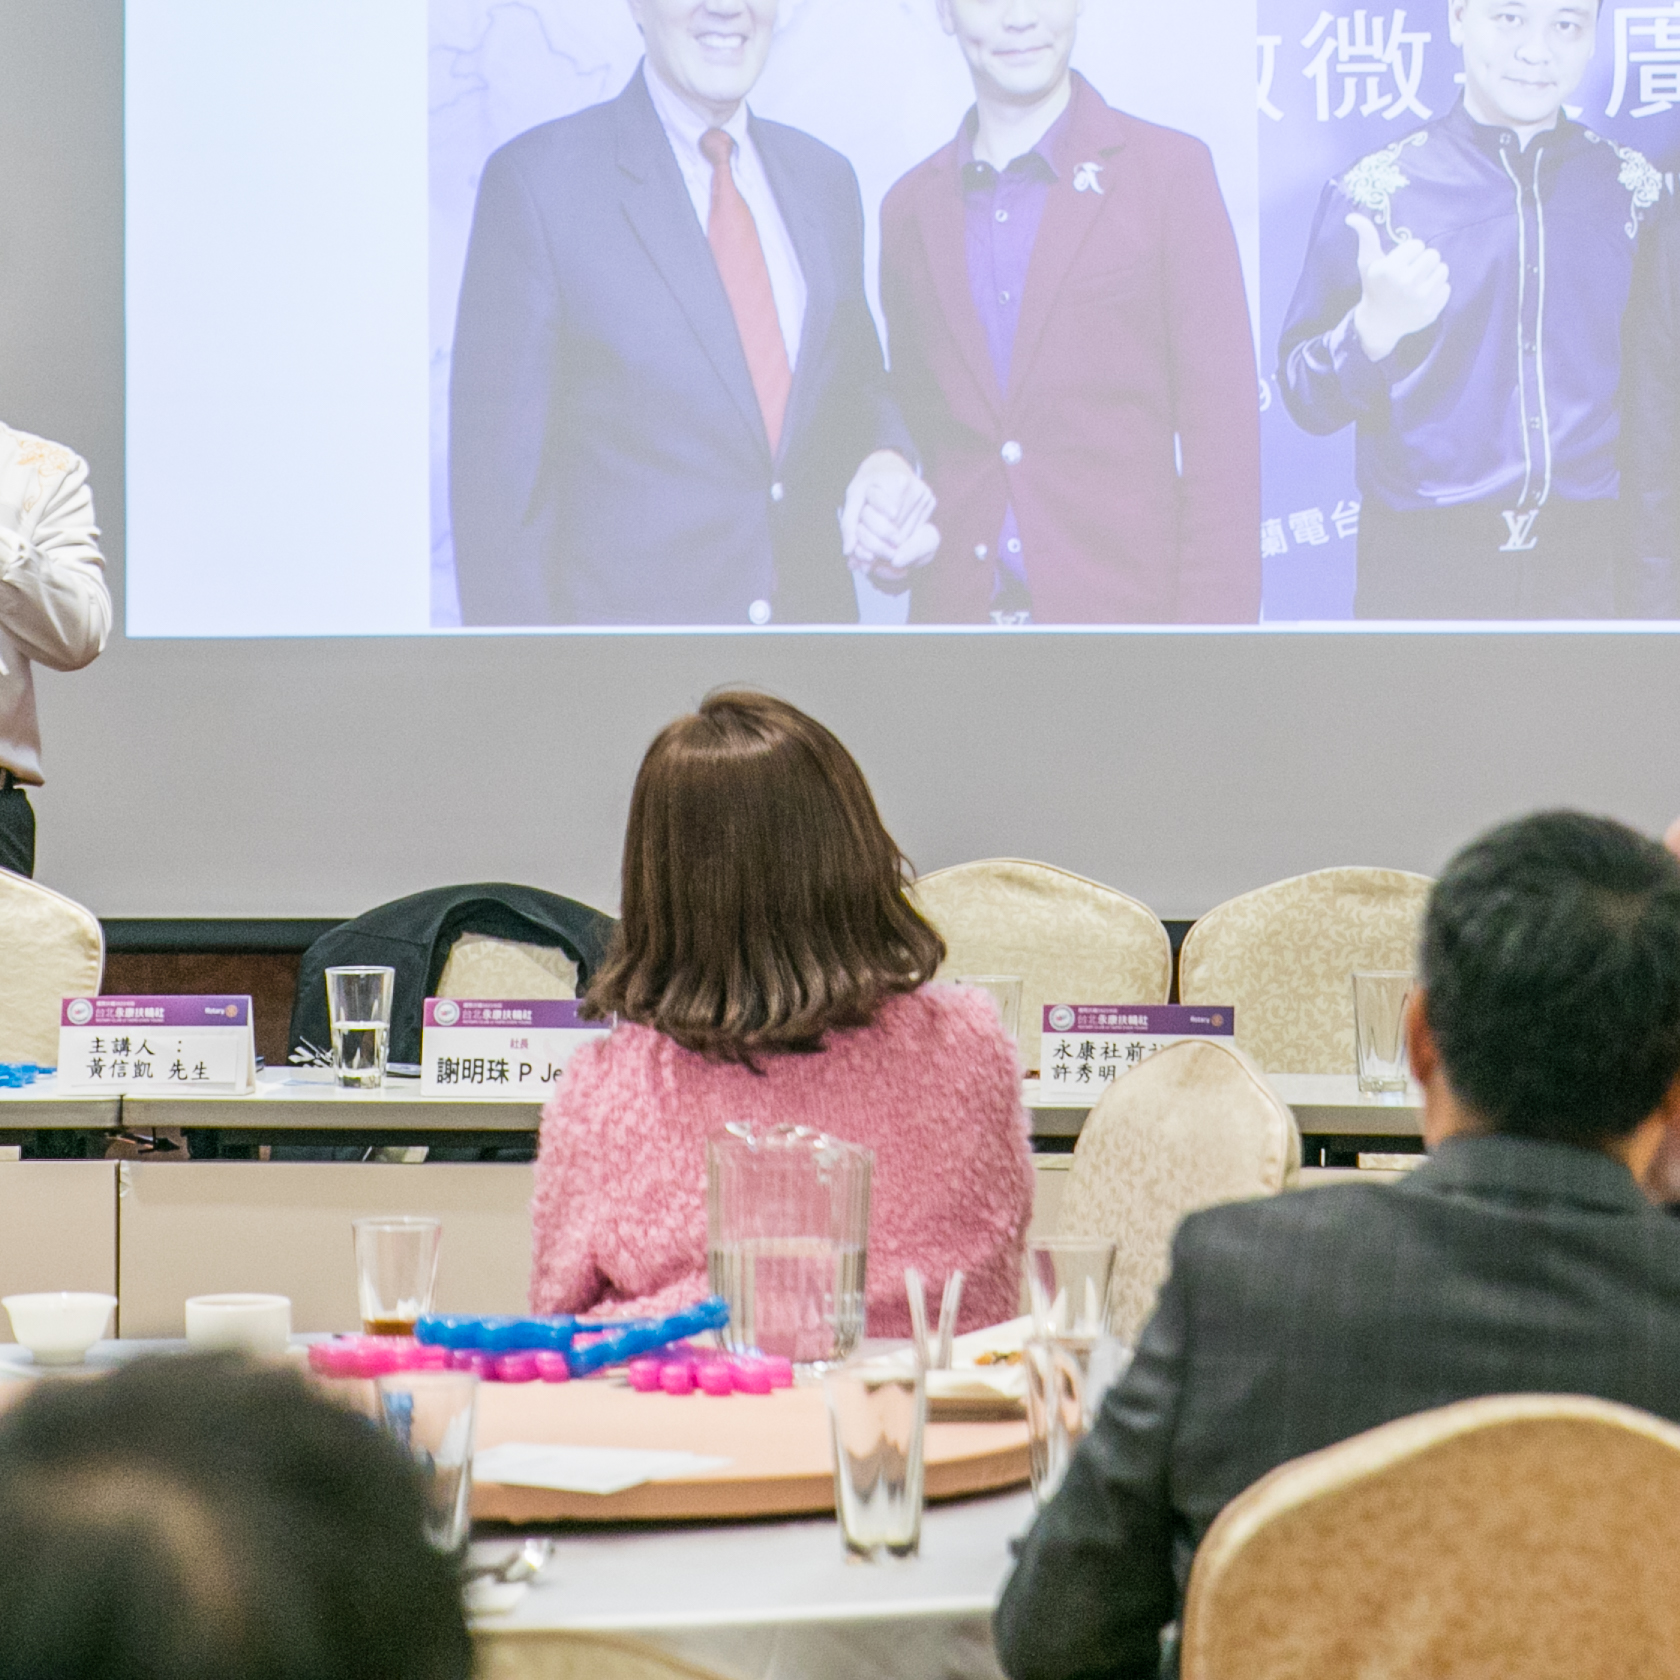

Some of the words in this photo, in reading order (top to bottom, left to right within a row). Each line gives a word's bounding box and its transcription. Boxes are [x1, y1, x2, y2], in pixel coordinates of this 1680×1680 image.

[510, 1038, 529, 1050] 社長
[86, 1057, 154, 1079] 黃信凱
[168, 1059, 210, 1081] 先生
[437, 1057, 510, 1084] 謝明珠
[519, 1063, 532, 1082] P
[1051, 1063, 1117, 1084] 許秀明
